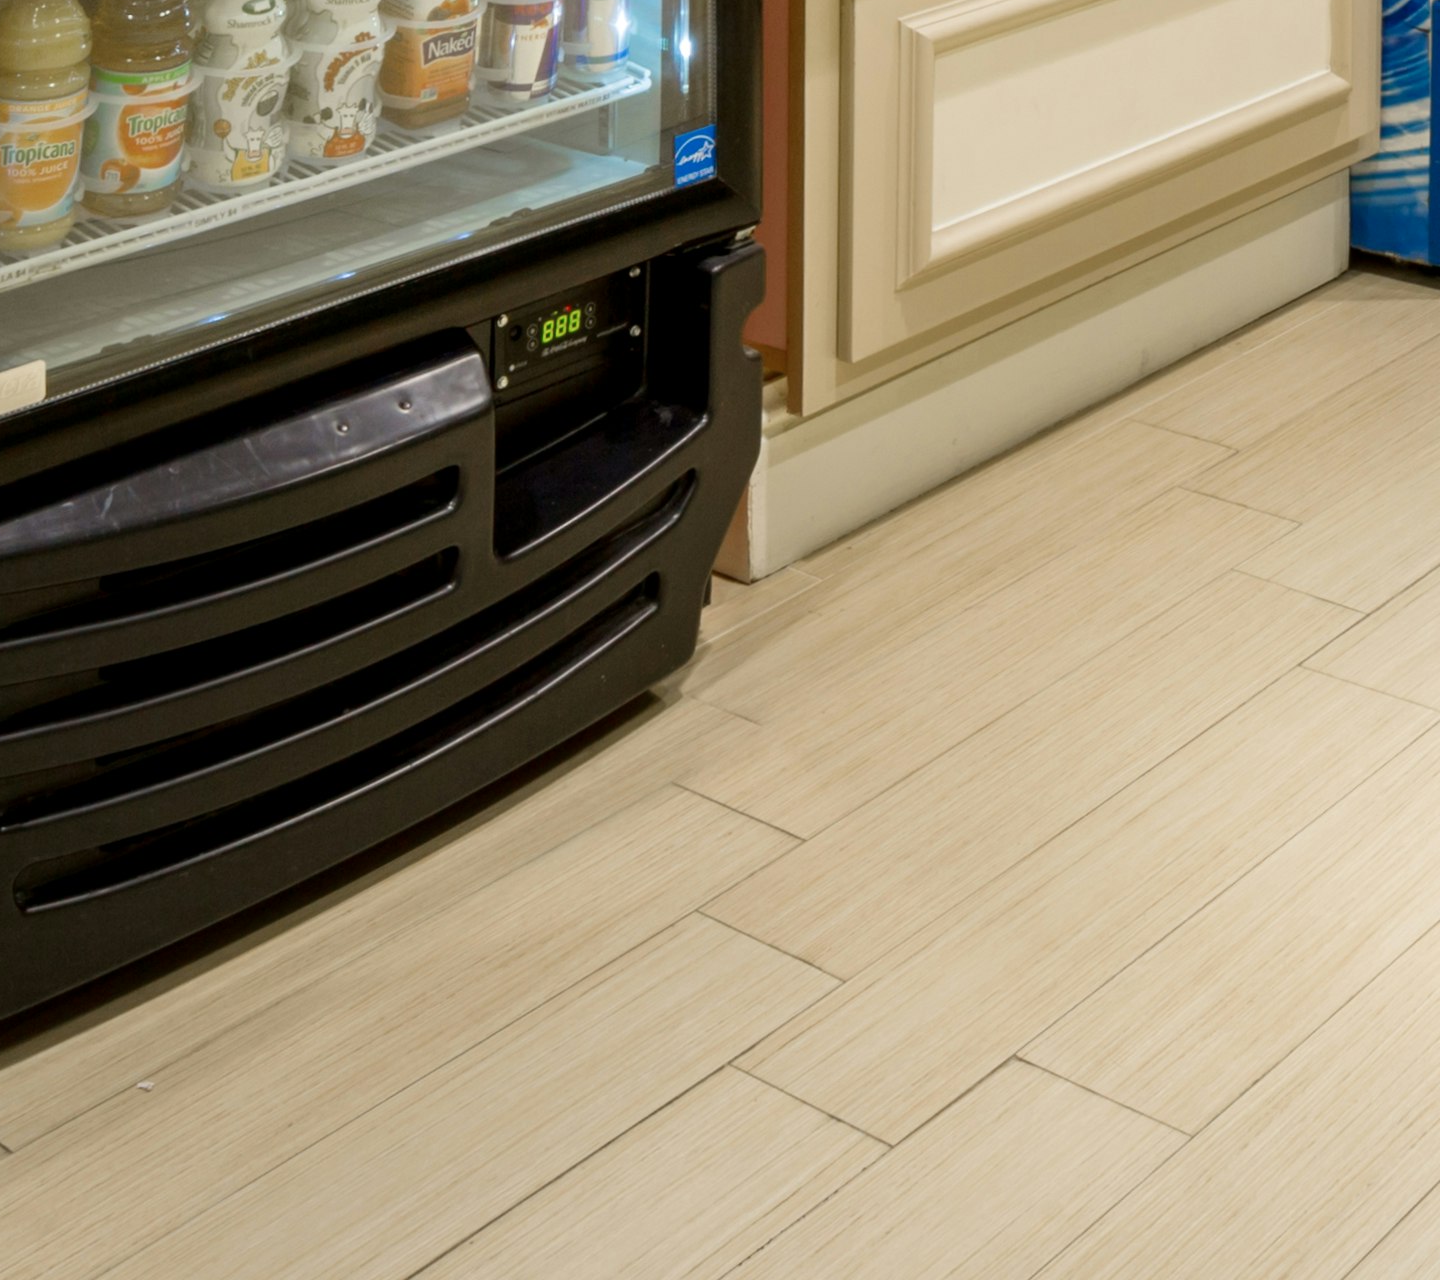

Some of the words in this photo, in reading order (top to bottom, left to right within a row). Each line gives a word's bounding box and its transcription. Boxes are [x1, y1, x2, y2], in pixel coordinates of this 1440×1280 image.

[227, 16, 272, 30] Shamrock
[428, 28, 475, 58] Naked
[1, 140, 75, 167] Tropicana
[7, 166, 37, 177] 100%
[39, 161, 69, 175] JUICE
[677, 172, 698, 185] ENERGY
[698, 166, 715, 180] STAR
[195, 210, 227, 227] SIMPLY
